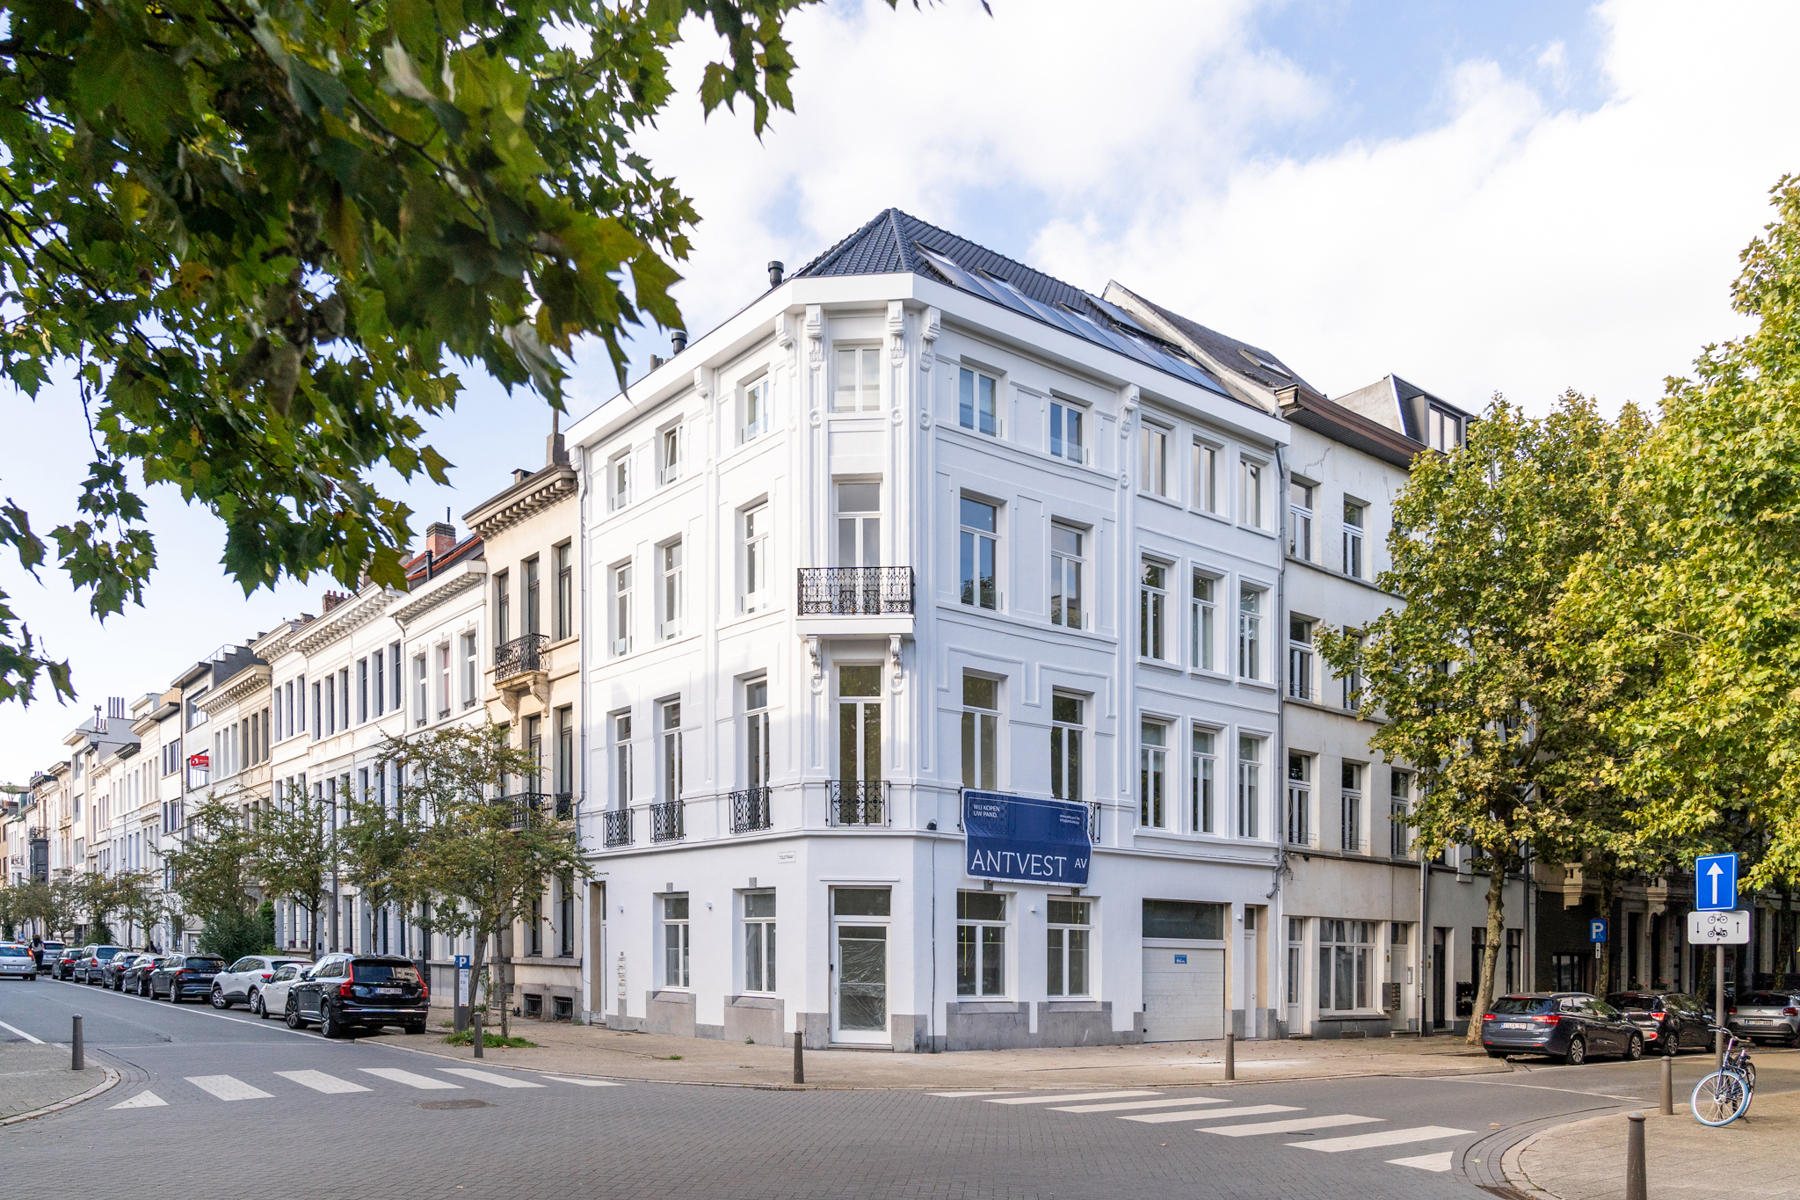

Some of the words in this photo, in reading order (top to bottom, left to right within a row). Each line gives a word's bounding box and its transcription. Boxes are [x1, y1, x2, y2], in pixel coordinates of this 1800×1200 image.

[971, 849, 1067, 877] ANTVEST
[1074, 858, 1087, 869] AV
[1592, 922, 1604, 939] P
[459, 956, 467, 967] P
